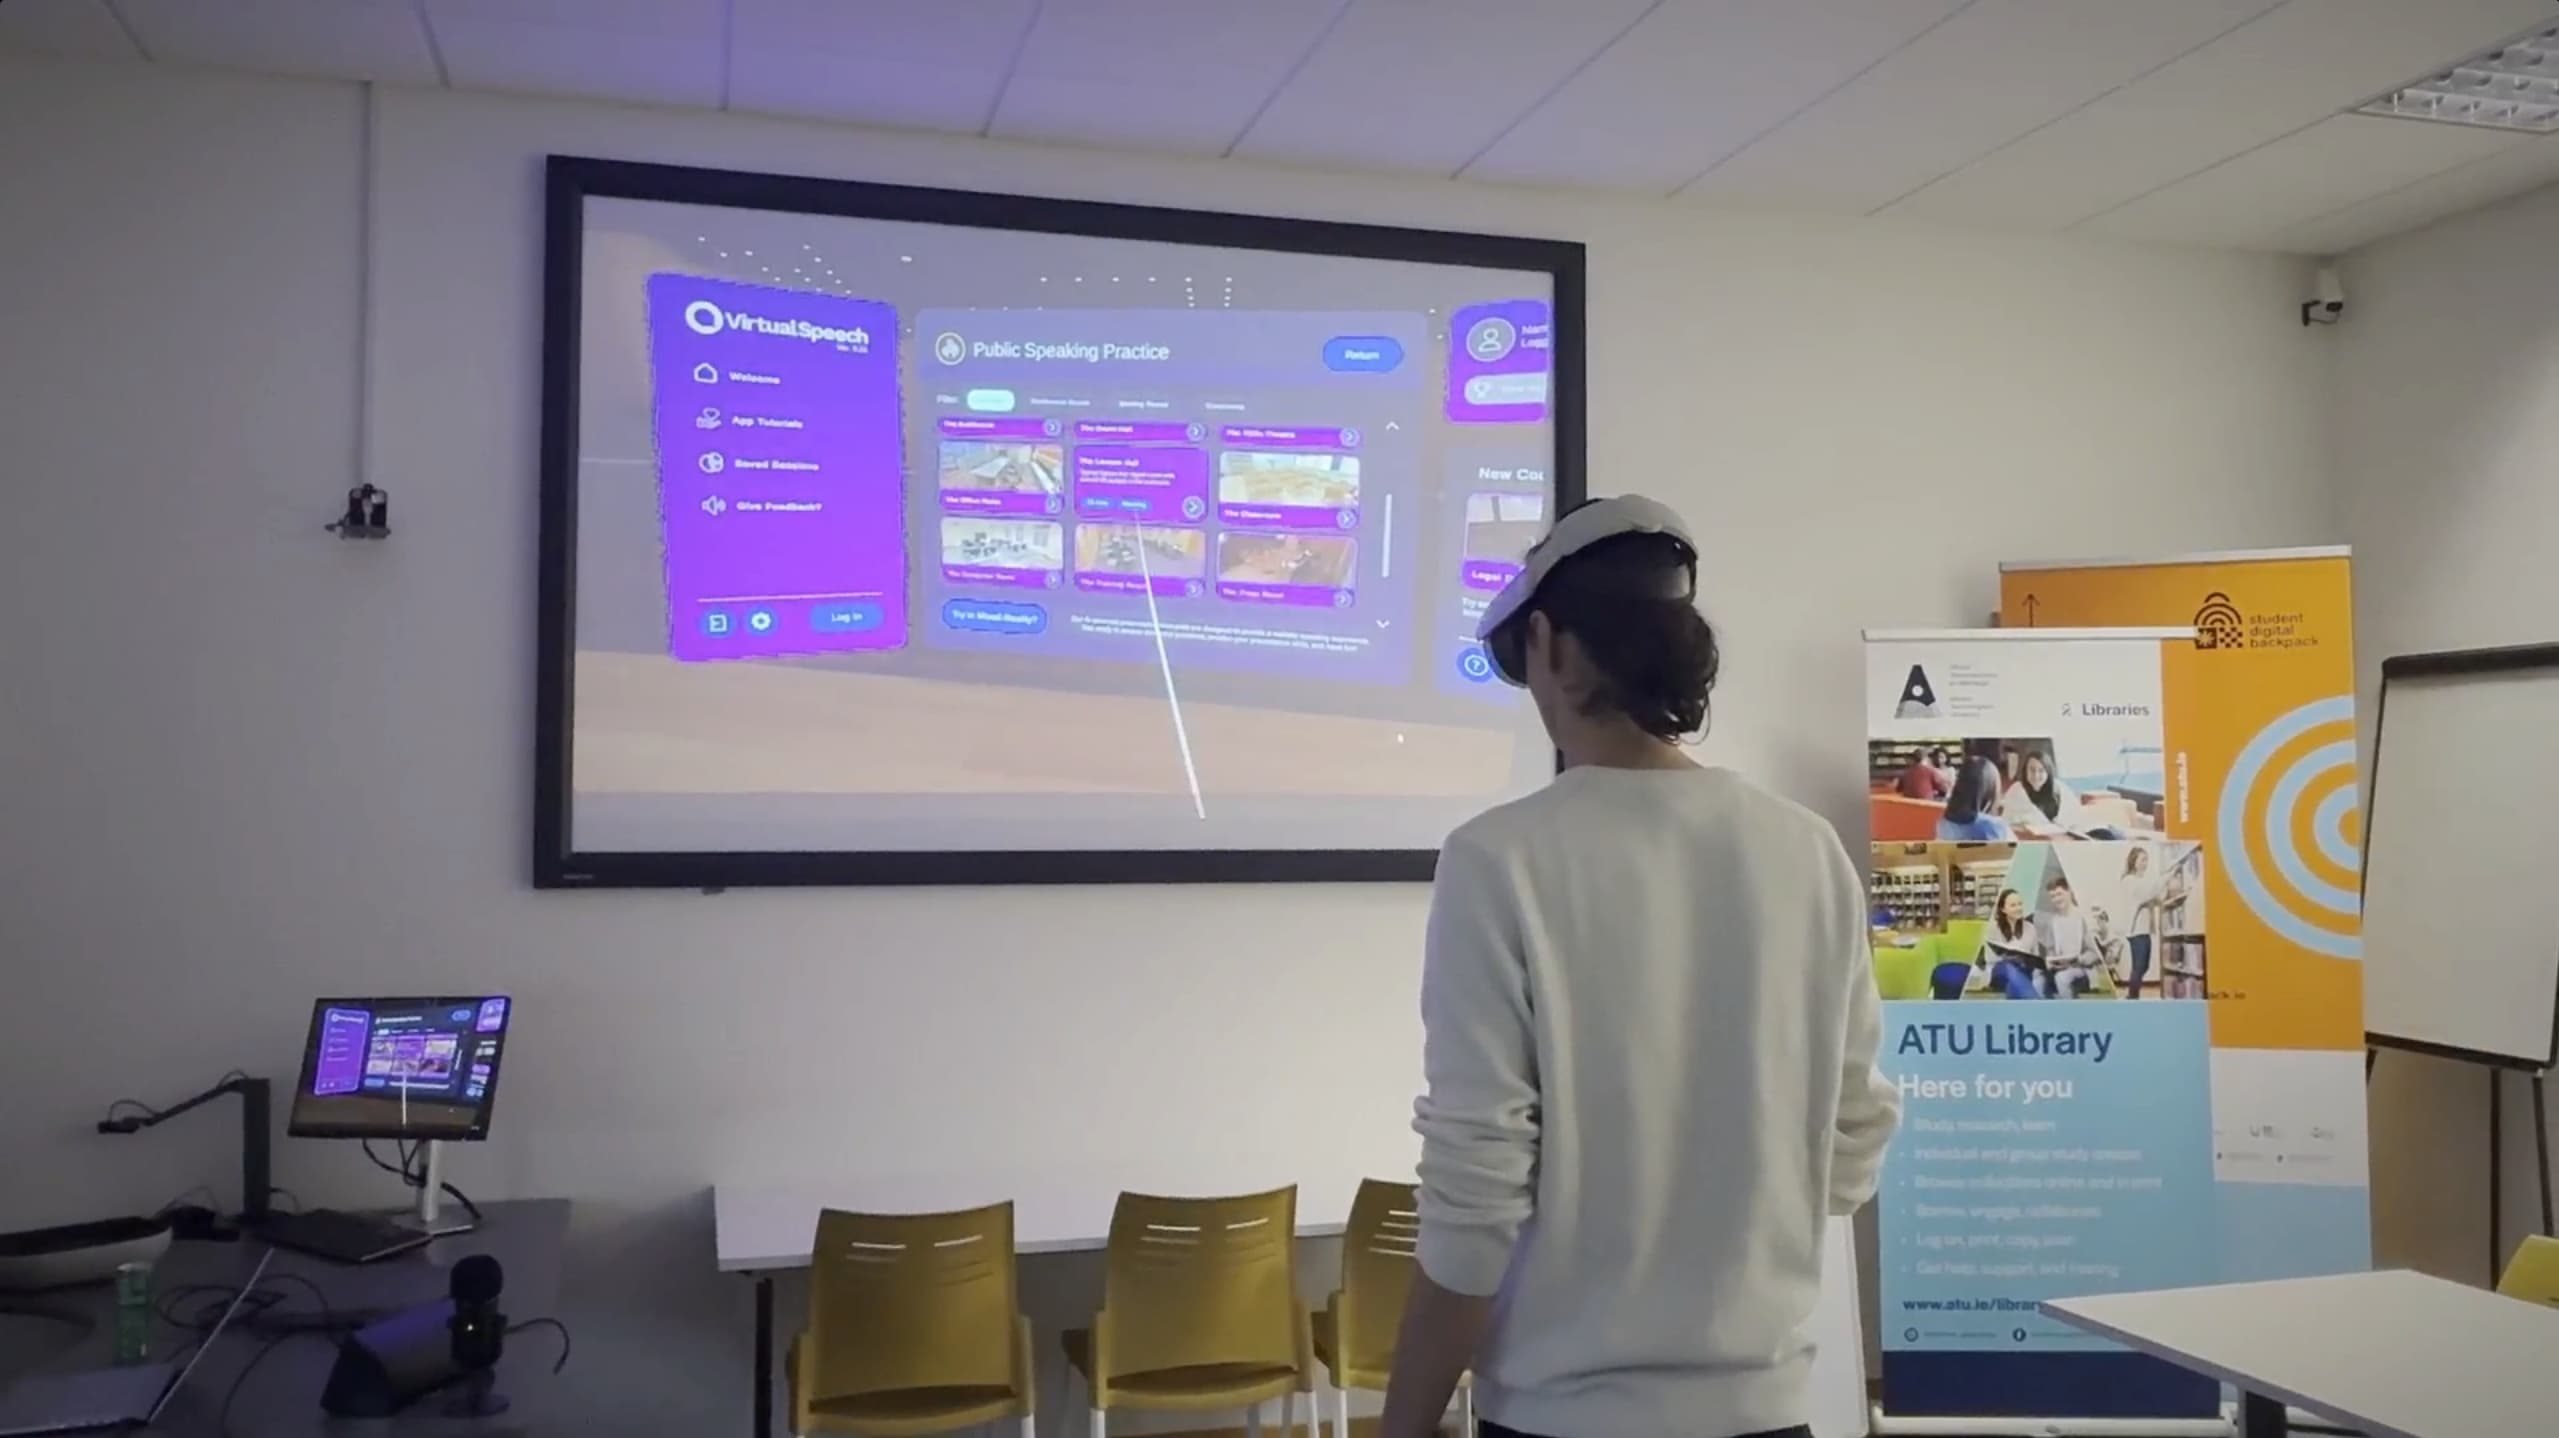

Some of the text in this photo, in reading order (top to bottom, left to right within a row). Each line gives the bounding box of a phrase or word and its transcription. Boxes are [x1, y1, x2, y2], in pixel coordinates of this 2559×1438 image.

[725, 311, 869, 344] VirtualSpeech
[973, 342, 1170, 362] Public Speaking Practice
[1345, 349, 1380, 360] Return
[729, 371, 780, 384] Welcome
[732, 416, 803, 428] App Tutorials
[1479, 467, 1512, 480] New
[736, 502, 762, 511] Give
[1471, 570, 1502, 582] Legal
[832, 612, 851, 624] Log
[953, 609, 965, 620] Try
[2249, 613, 2304, 624] student
[2249, 624, 2295, 637] digital
[2249, 635, 2319, 649] backpack
[2082, 703, 2150, 717] Libraries
[1898, 1024, 2113, 1063] ATU Library
[1899, 1074, 2073, 1104] Here for you
[1913, 1118, 1955, 1136] Study
[1981, 1147, 2009, 1161] and
[2009, 1149, 2049, 1167] group
[2051, 1147, 2088, 1164] study
[1913, 1175, 1965, 1189] Browse
[1968, 1174, 2042, 1189] collections
[2043, 1176, 2085, 1189] online
[2088, 1175, 2114, 1189] and
[2117, 1176, 2129, 1188] in
[1916, 1233, 1942, 1249] Log
[1916, 1260, 1942, 1275] Get
[2039, 1260, 2067, 1274] and
